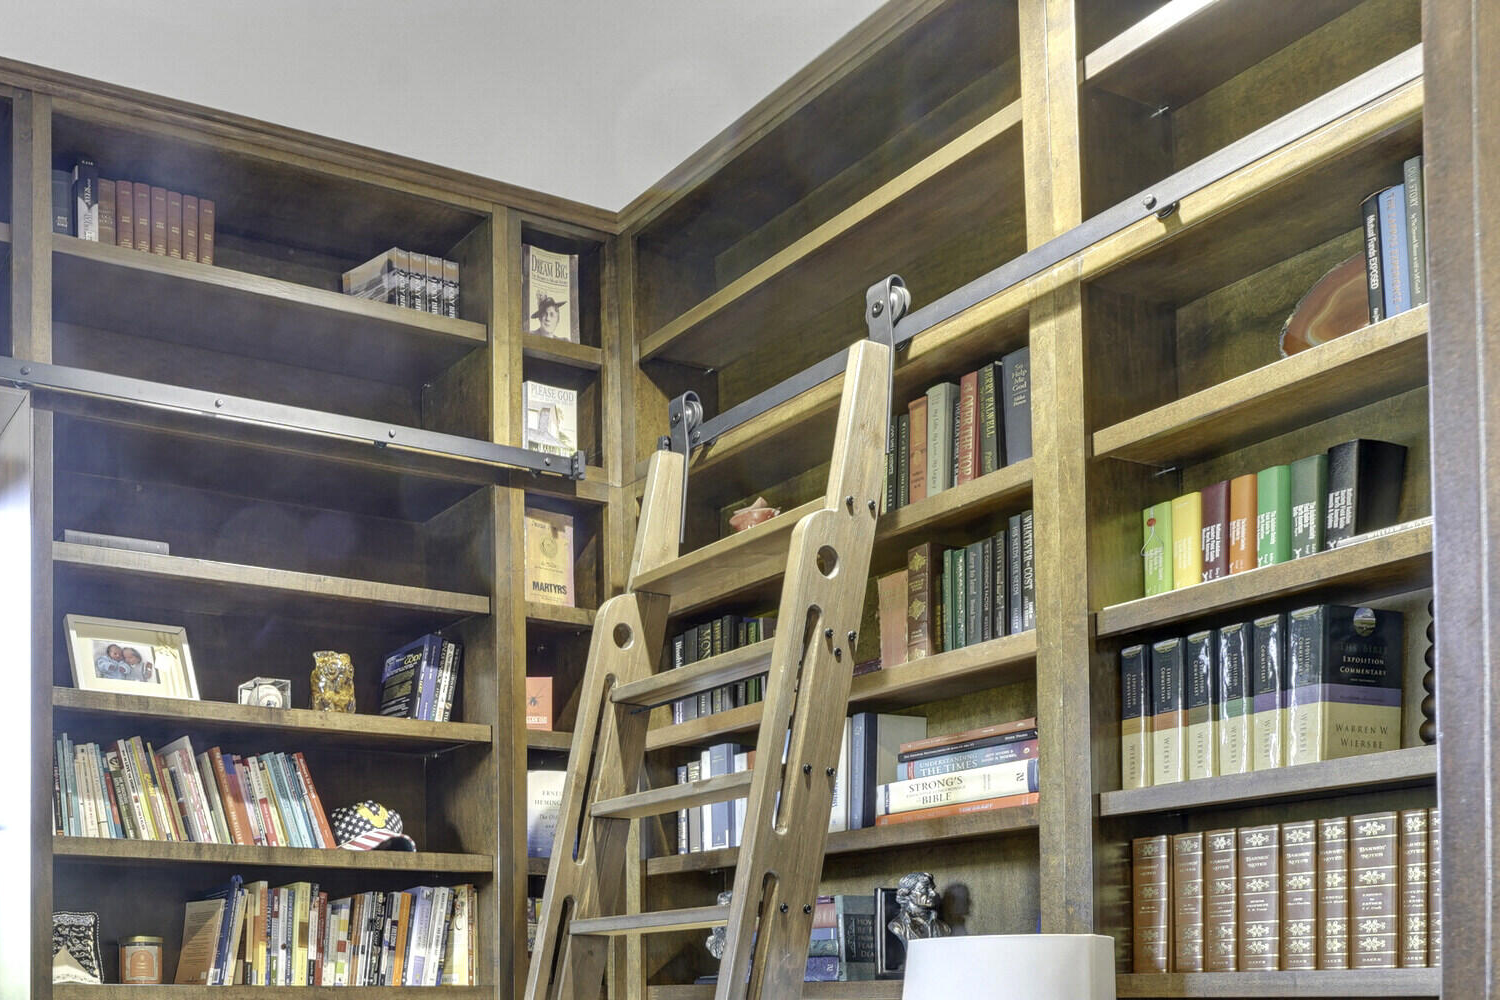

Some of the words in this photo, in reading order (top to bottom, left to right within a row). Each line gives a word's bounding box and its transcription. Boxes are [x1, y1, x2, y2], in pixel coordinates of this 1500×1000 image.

[1367, 214, 1375, 236] Mutual
[1368, 237, 1376, 258] Funds
[532, 255, 553, 277] DREAM
[555, 261, 568, 279] BIG
[1369, 258, 1379, 290] EXPOSED
[1012, 370, 1027, 379] Help
[531, 384, 556, 399] PLEASE
[558, 391, 574, 400] GOD
[1012, 383, 1027, 391] God
[987, 395, 996, 438] FALWELL
[964, 421, 972, 448] THE
[964, 451, 972, 475] TOP
[532, 581, 567, 595] MARTYRS
[1343, 656, 1384, 665] EXPOSITION
[1340, 666, 1386, 676] COMMENTARY
[1336, 724, 1376, 734] WARREN
[919, 753, 978, 769] UNDERSTANDING
[920, 766, 943, 776] THE
[946, 759, 978, 772] TIMES
[909, 776, 963, 792] STRONG'S
[922, 791, 952, 805] BIBLE
